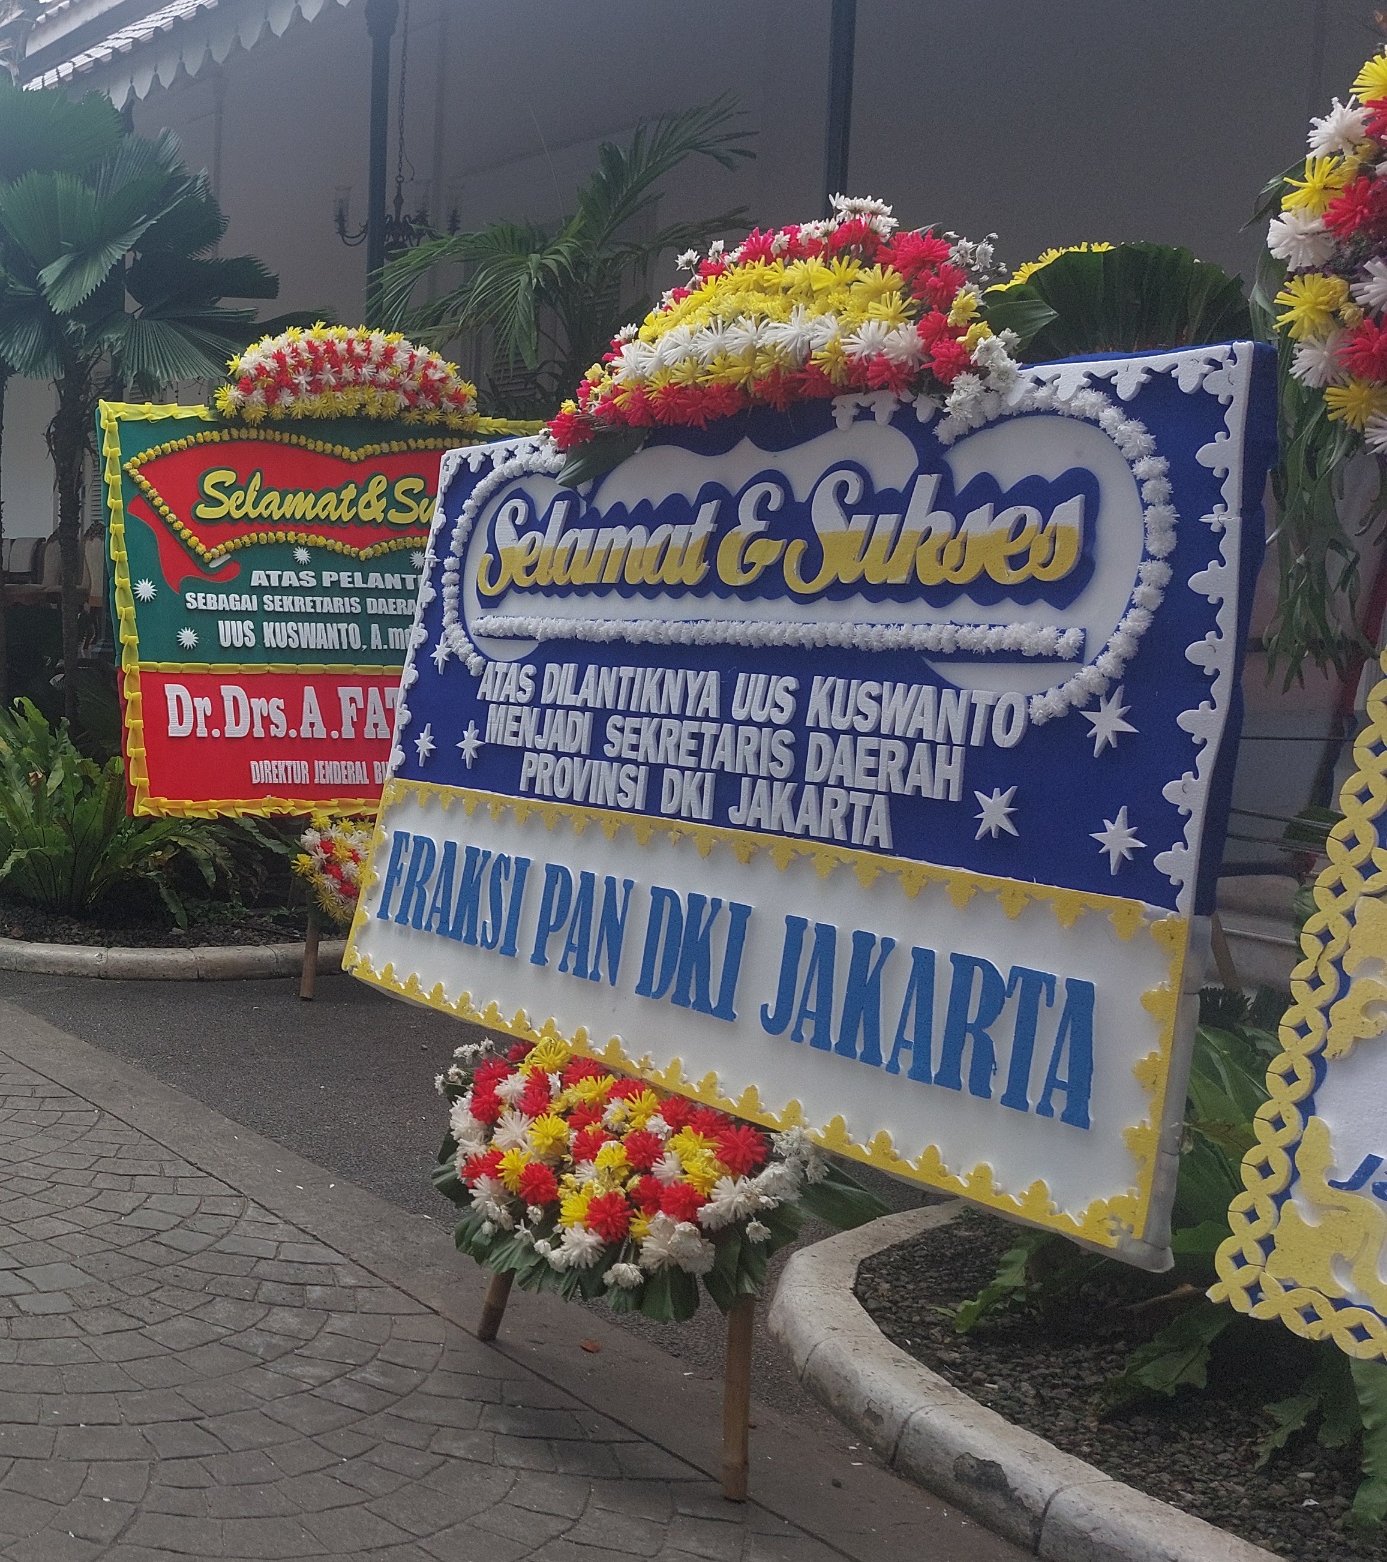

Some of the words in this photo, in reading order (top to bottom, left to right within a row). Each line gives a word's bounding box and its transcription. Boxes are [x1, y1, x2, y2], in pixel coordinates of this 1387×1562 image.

[196, 469, 358, 520] Selamat
[357, 474, 388, 523] &
[477, 498, 720, 596] Selamat
[716, 481, 787, 586] &
[783, 469, 1085, 594] Sukses
[185, 592, 258, 611] SEBAGAI
[263, 594, 361, 614] SEKRETARIS
[366, 597, 415, 615] DAERA
[250, 570, 317, 588] ATAS
[322, 571, 424, 590] PELANT
[218, 620, 256, 648] UUS
[476, 661, 537, 703] ATAS
[541, 664, 721, 718] DILANTIKNYA
[731, 672, 800, 725] UUS
[805, 676, 1029, 749] KUSWANTO
[250, 760, 310, 785] DIREKTUR
[314, 760, 369, 785] JENDERAL
[485, 703, 594, 755] MENJADI
[603, 716, 795, 779] SEKRETARIS
[805, 732, 966, 801] DAERAH
[520, 752, 650, 810] PROVINSI
[661, 768, 715, 820] DKI
[728, 776, 893, 849] JAKARTA
[376, 830, 532, 958] FRAKSI
[529, 862, 635, 988] PAN
[634, 886, 754, 1022] DKI
[760, 915, 1098, 1130] JAKARTA
